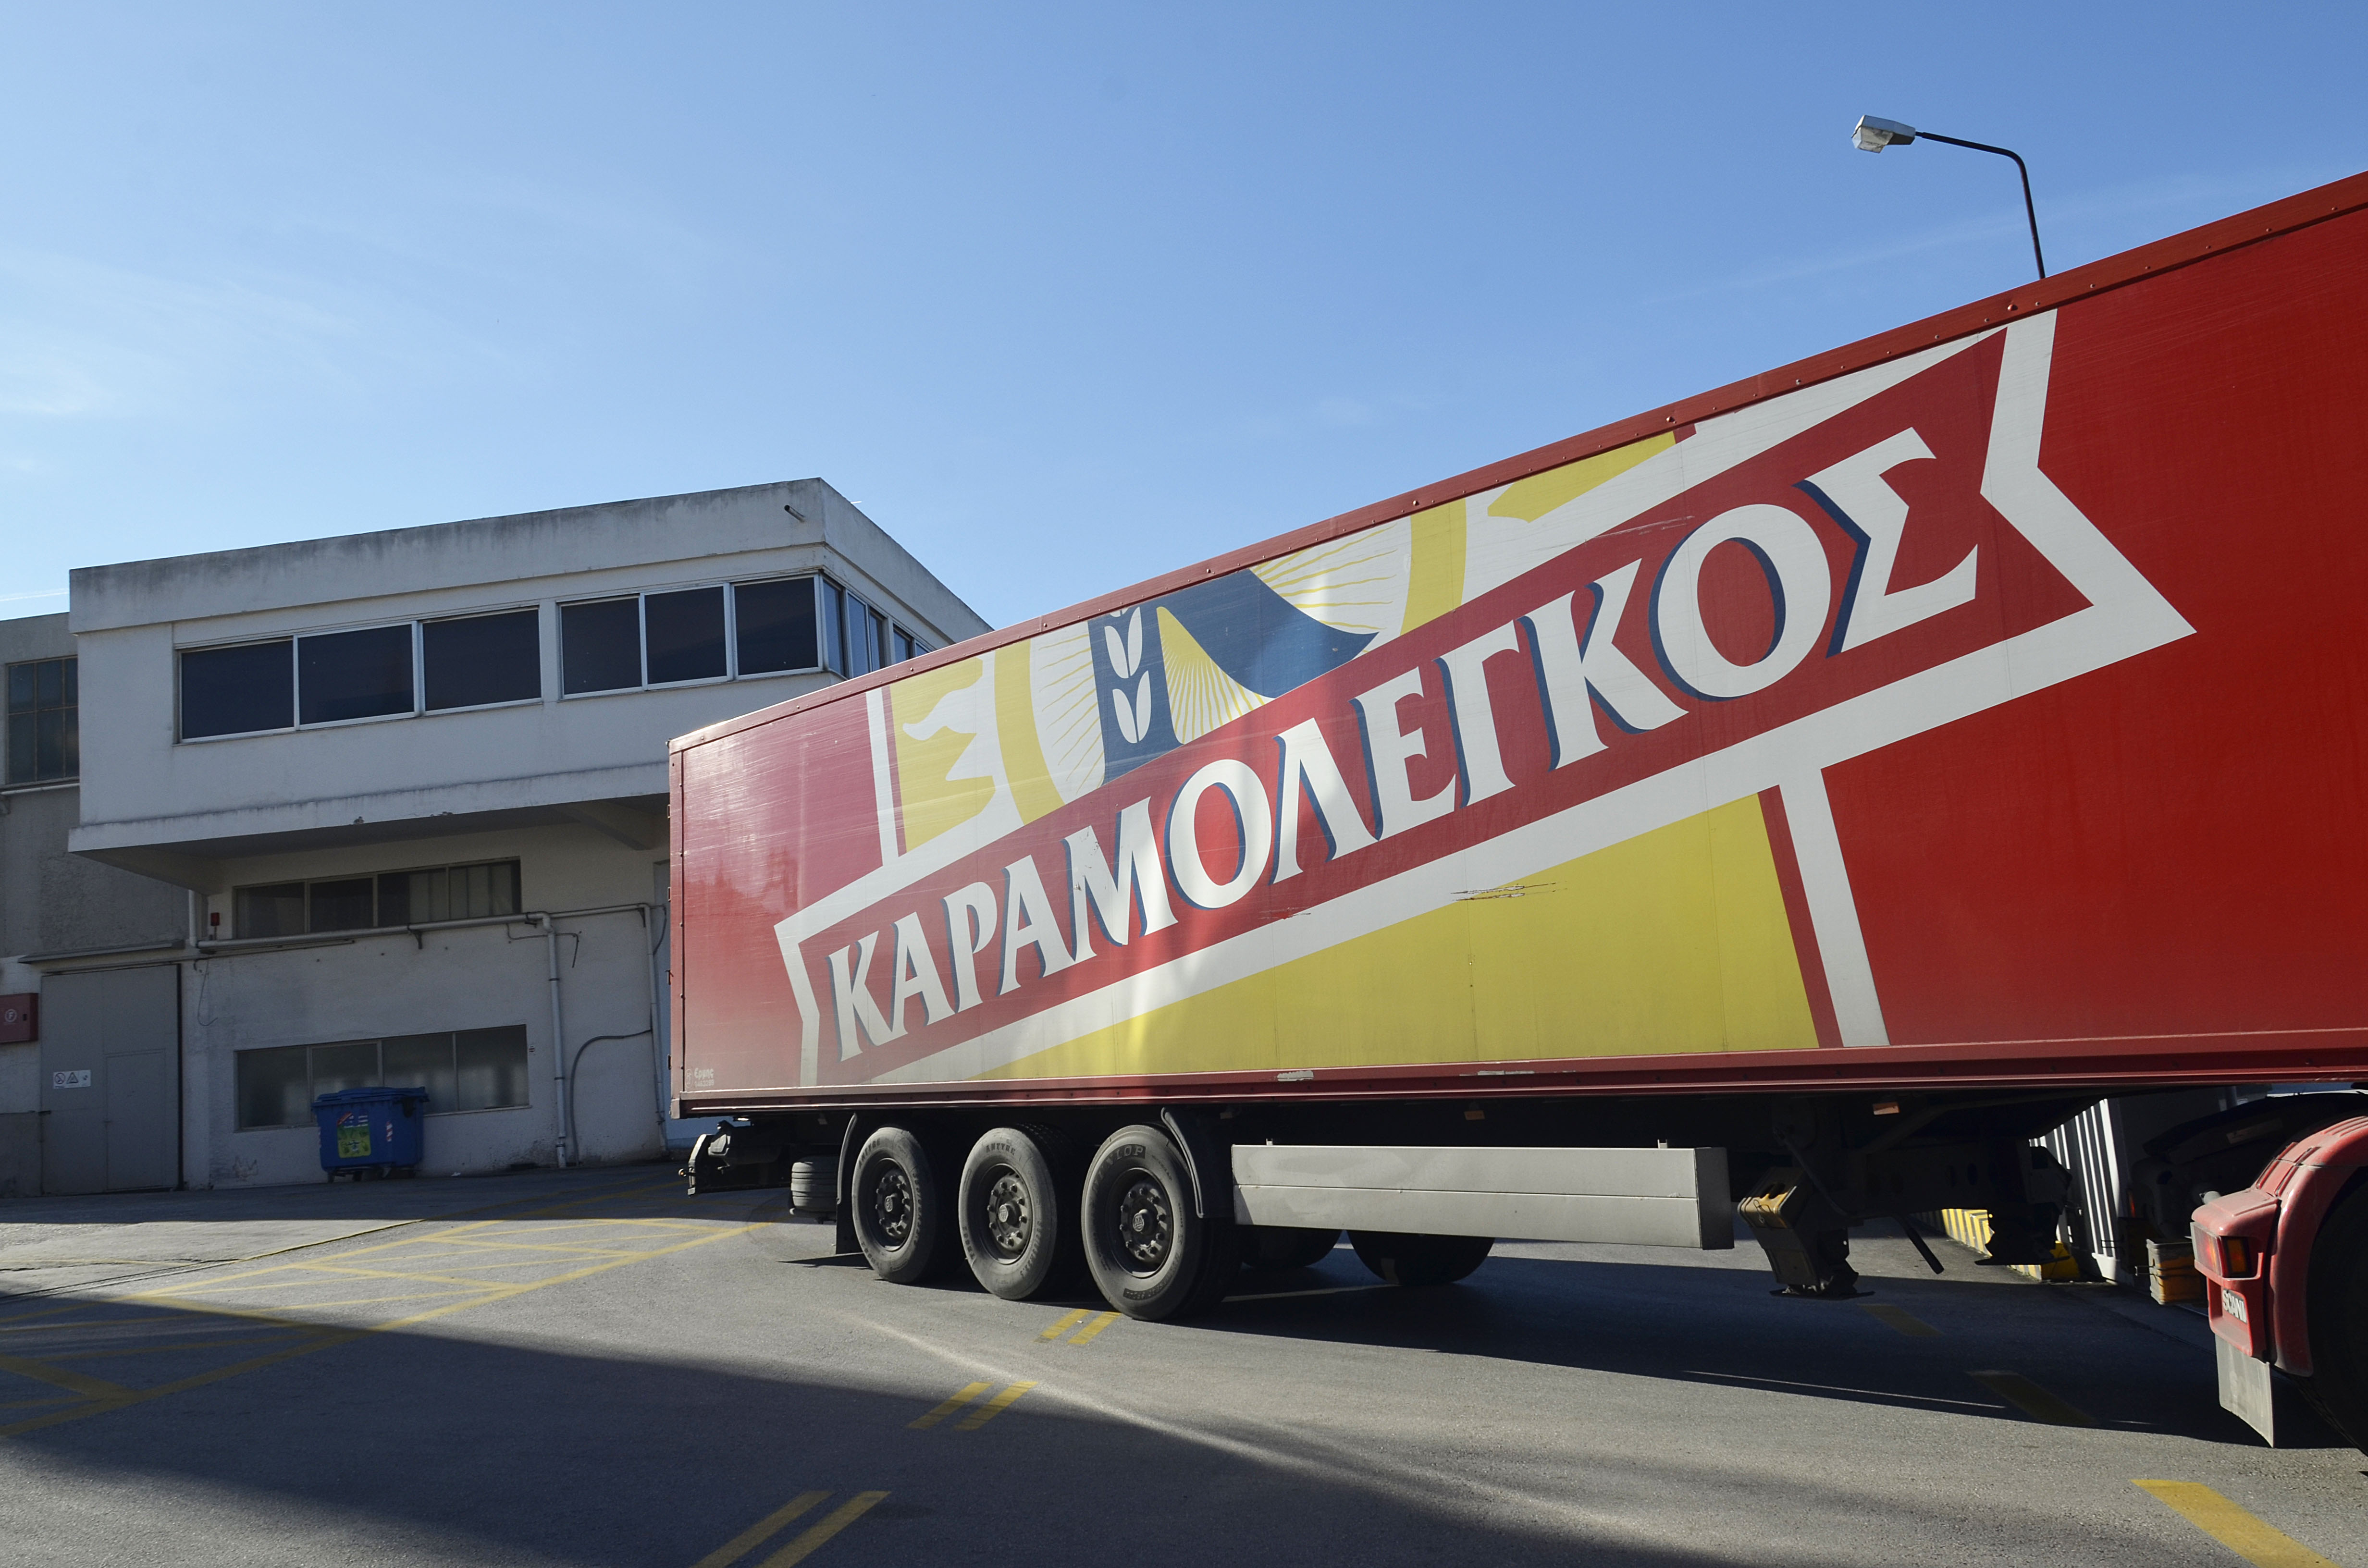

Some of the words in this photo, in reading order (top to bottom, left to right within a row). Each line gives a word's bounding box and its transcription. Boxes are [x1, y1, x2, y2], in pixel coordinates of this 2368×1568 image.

[826, 427, 1977, 1061] ΚΑΡΑΜΟΛΕΓΚΟΣ
[858, 1138, 881, 1169] ANTYRE
[986, 1143, 1016, 1156] ANTYRE
